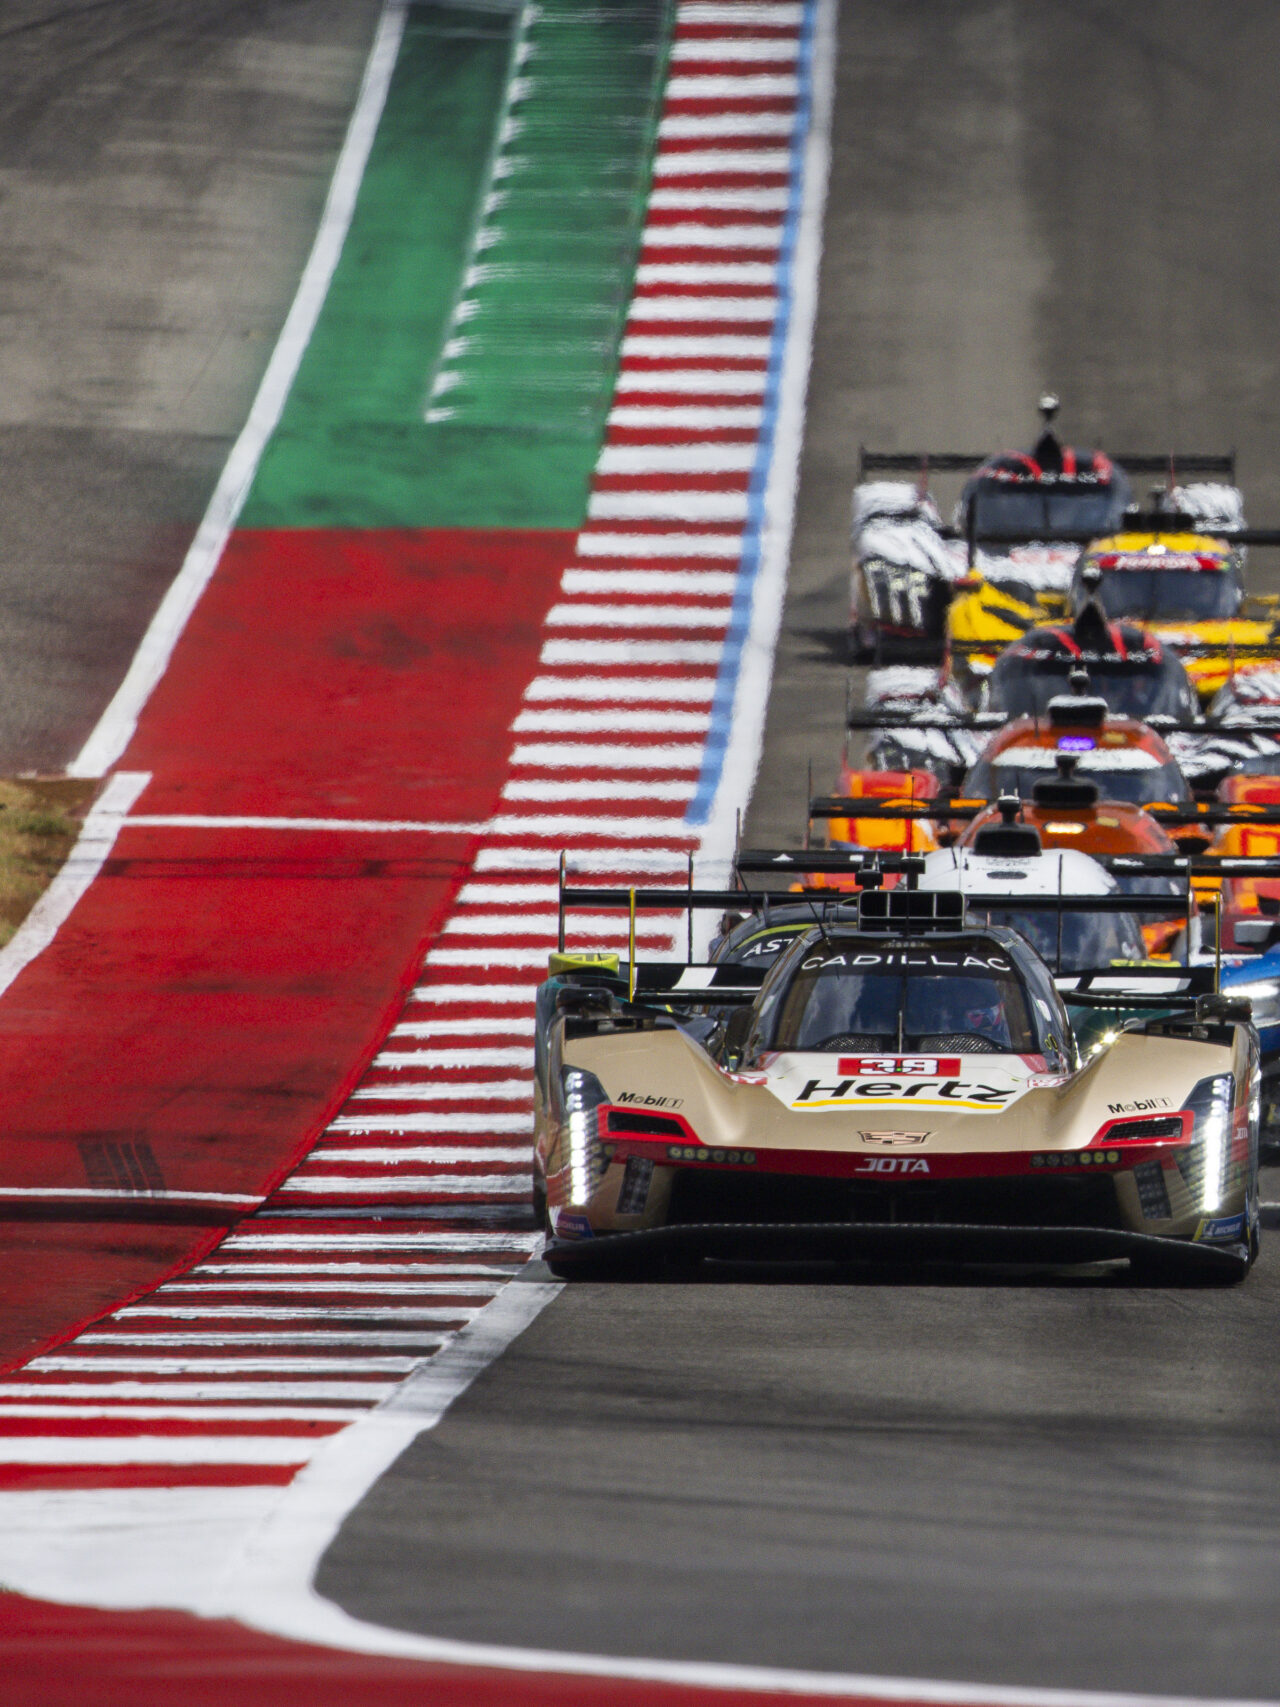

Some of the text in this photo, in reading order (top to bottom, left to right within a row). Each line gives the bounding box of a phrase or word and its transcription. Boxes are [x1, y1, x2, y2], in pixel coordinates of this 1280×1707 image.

[801, 954, 1011, 971] CADILLAC
[796, 1079, 1017, 1103] Hertz
[617, 1092, 667, 1107] Mobil
[1107, 1098, 1156, 1114] Mobil
[855, 1158, 930, 1173] JOTA
